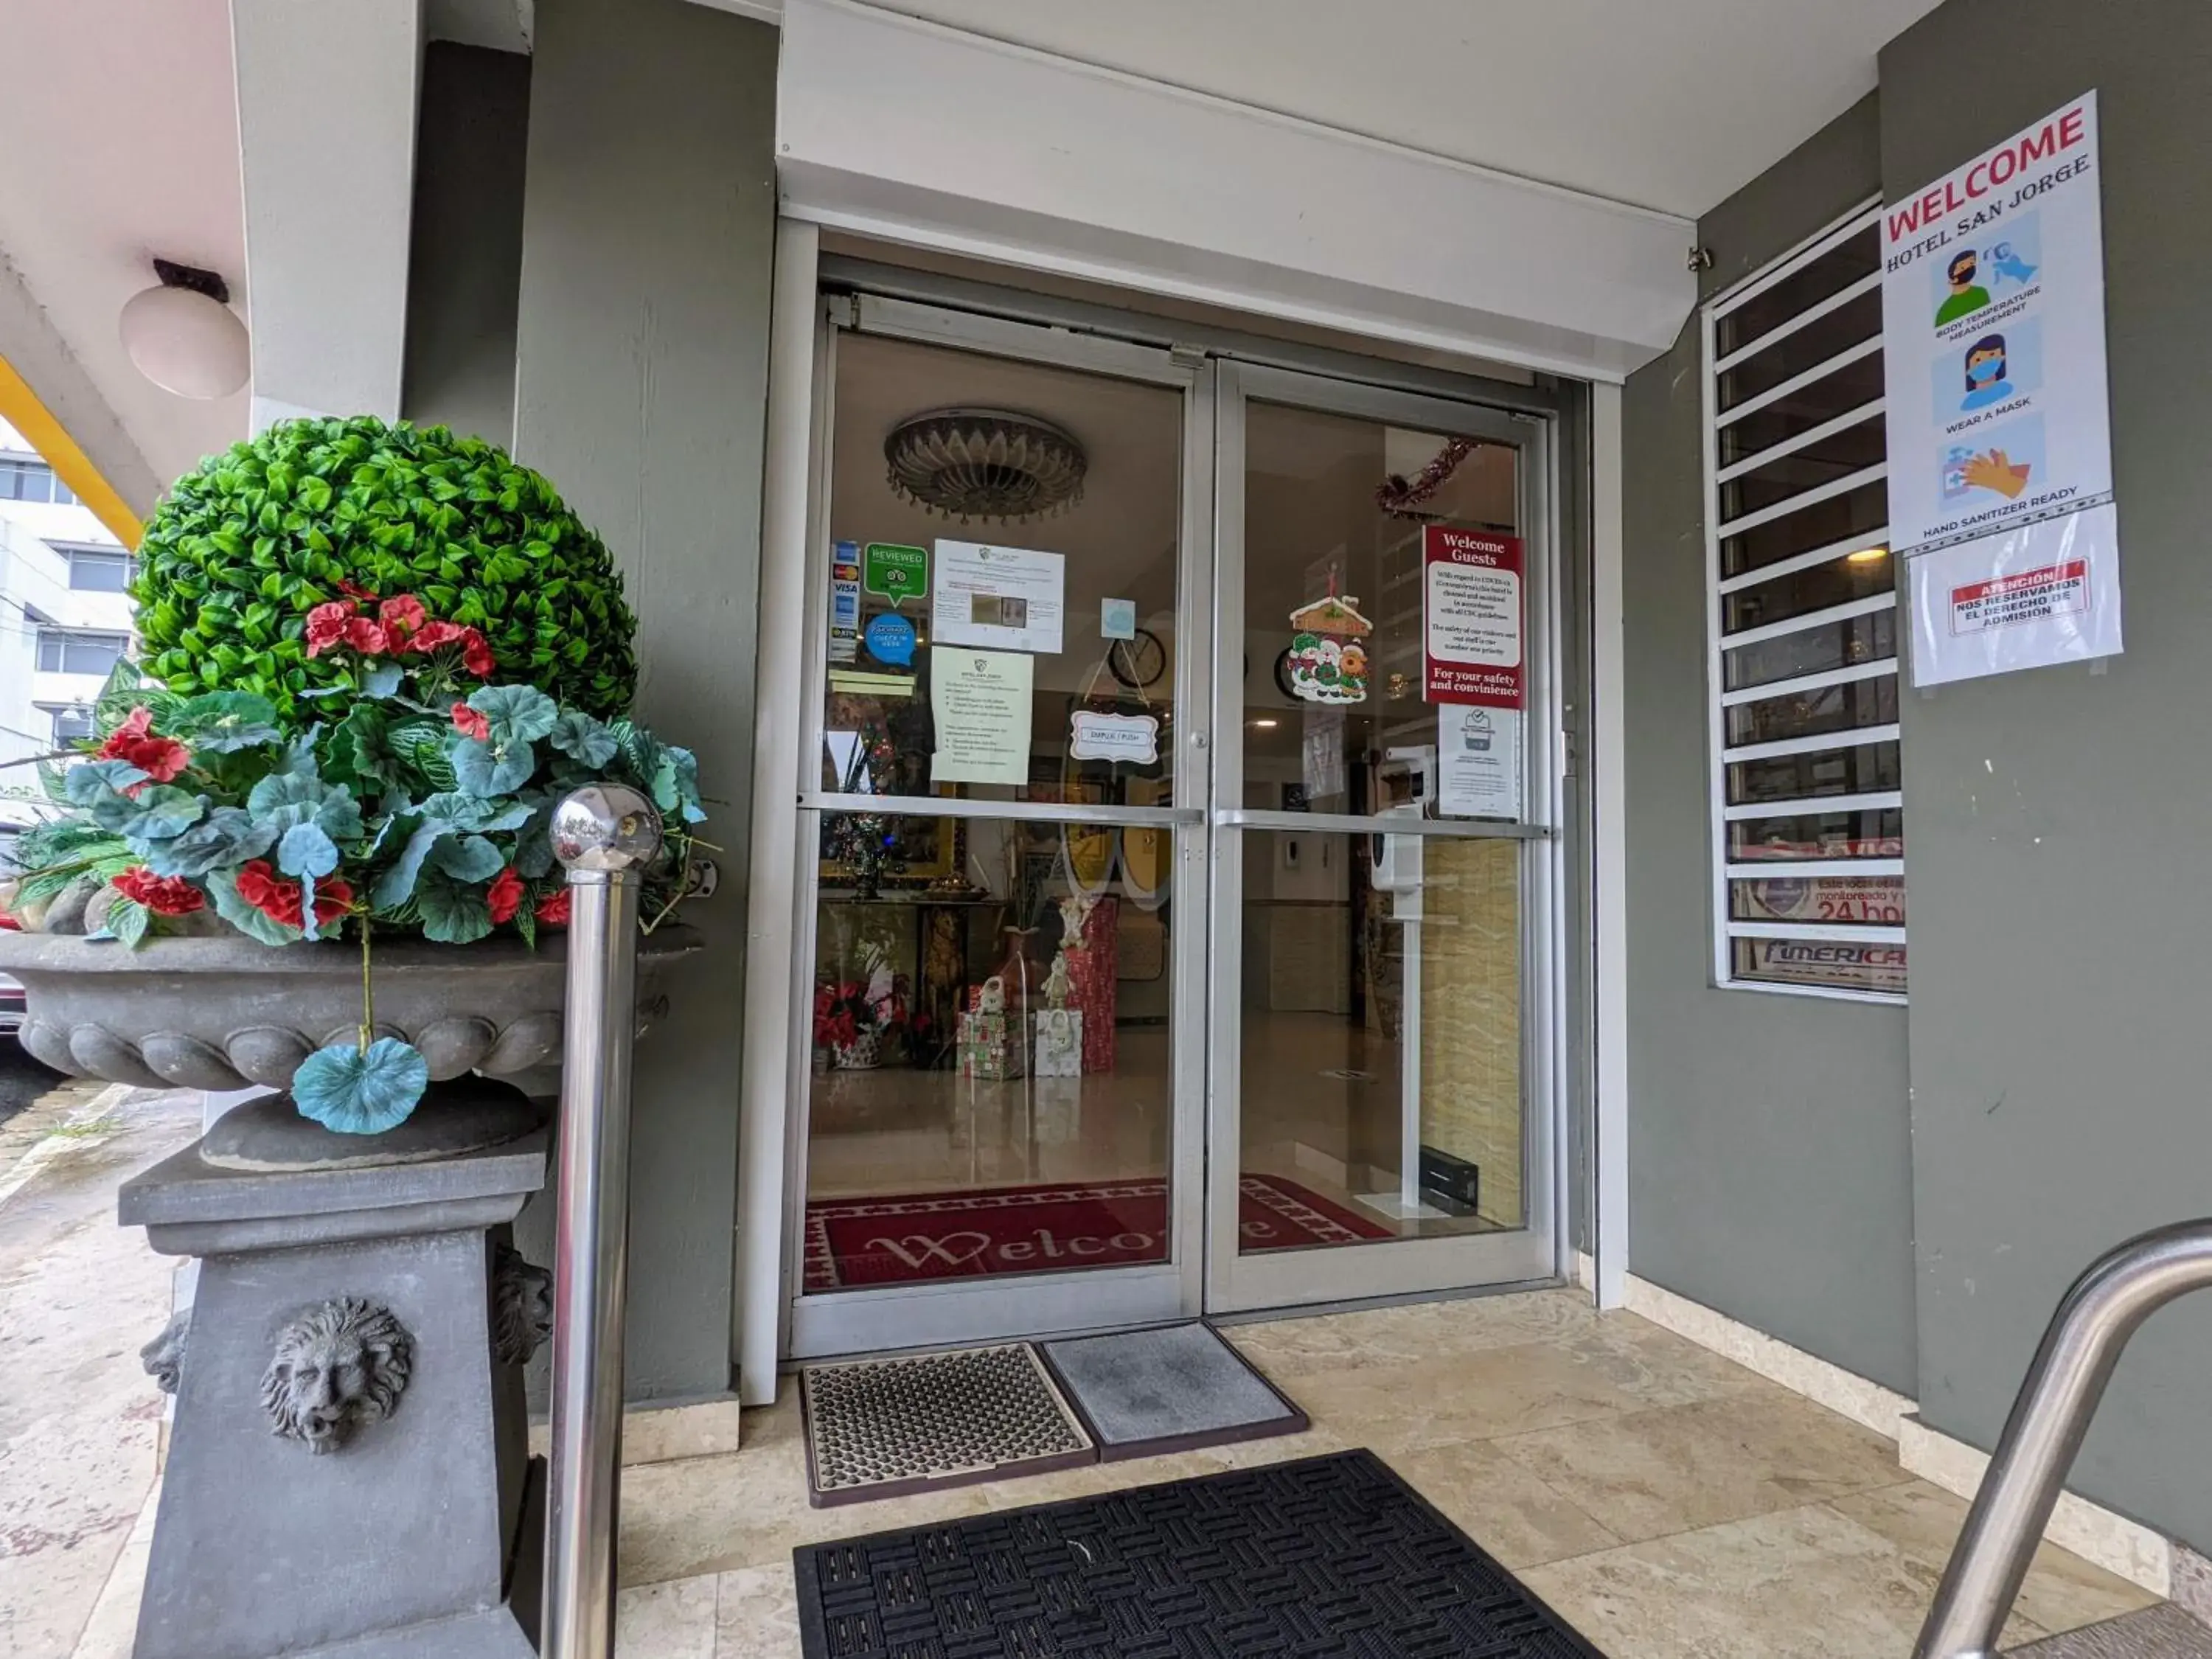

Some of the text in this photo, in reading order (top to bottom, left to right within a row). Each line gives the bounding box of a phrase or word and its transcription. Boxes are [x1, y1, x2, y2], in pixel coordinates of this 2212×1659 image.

[1888, 108, 2084, 243] WELCOME
[1887, 153, 2091, 274] HOTEL SAN JORGE
[1936, 286, 2041, 338] BODY TEMPERATURE
[1949, 302, 2027, 342] MEASUREMENT
[1947, 397, 2031, 434] WEAR A MASK
[1923, 486, 2078, 538] HAND SANITIZER READY
[872, 548, 922, 563] REVIEWED
[1443, 532, 1505, 553] Welcome
[1451, 549, 1496, 566] Guests
[835, 583, 857, 593] VISA
[1956, 579, 2080, 613] NOS RESERVAMOS
[1980, 571, 2053, 596] ATENCIÓN
[1965, 591, 2072, 620] EL DERECHO DE
[1983, 605, 2052, 627] ADMISIÓN
[1430, 680, 1519, 696] and convinience
[1433, 667, 1515, 687] For your safety
[1818, 902, 1905, 921] 24 ho
[864, 1224, 1277, 1274] Welcoe
